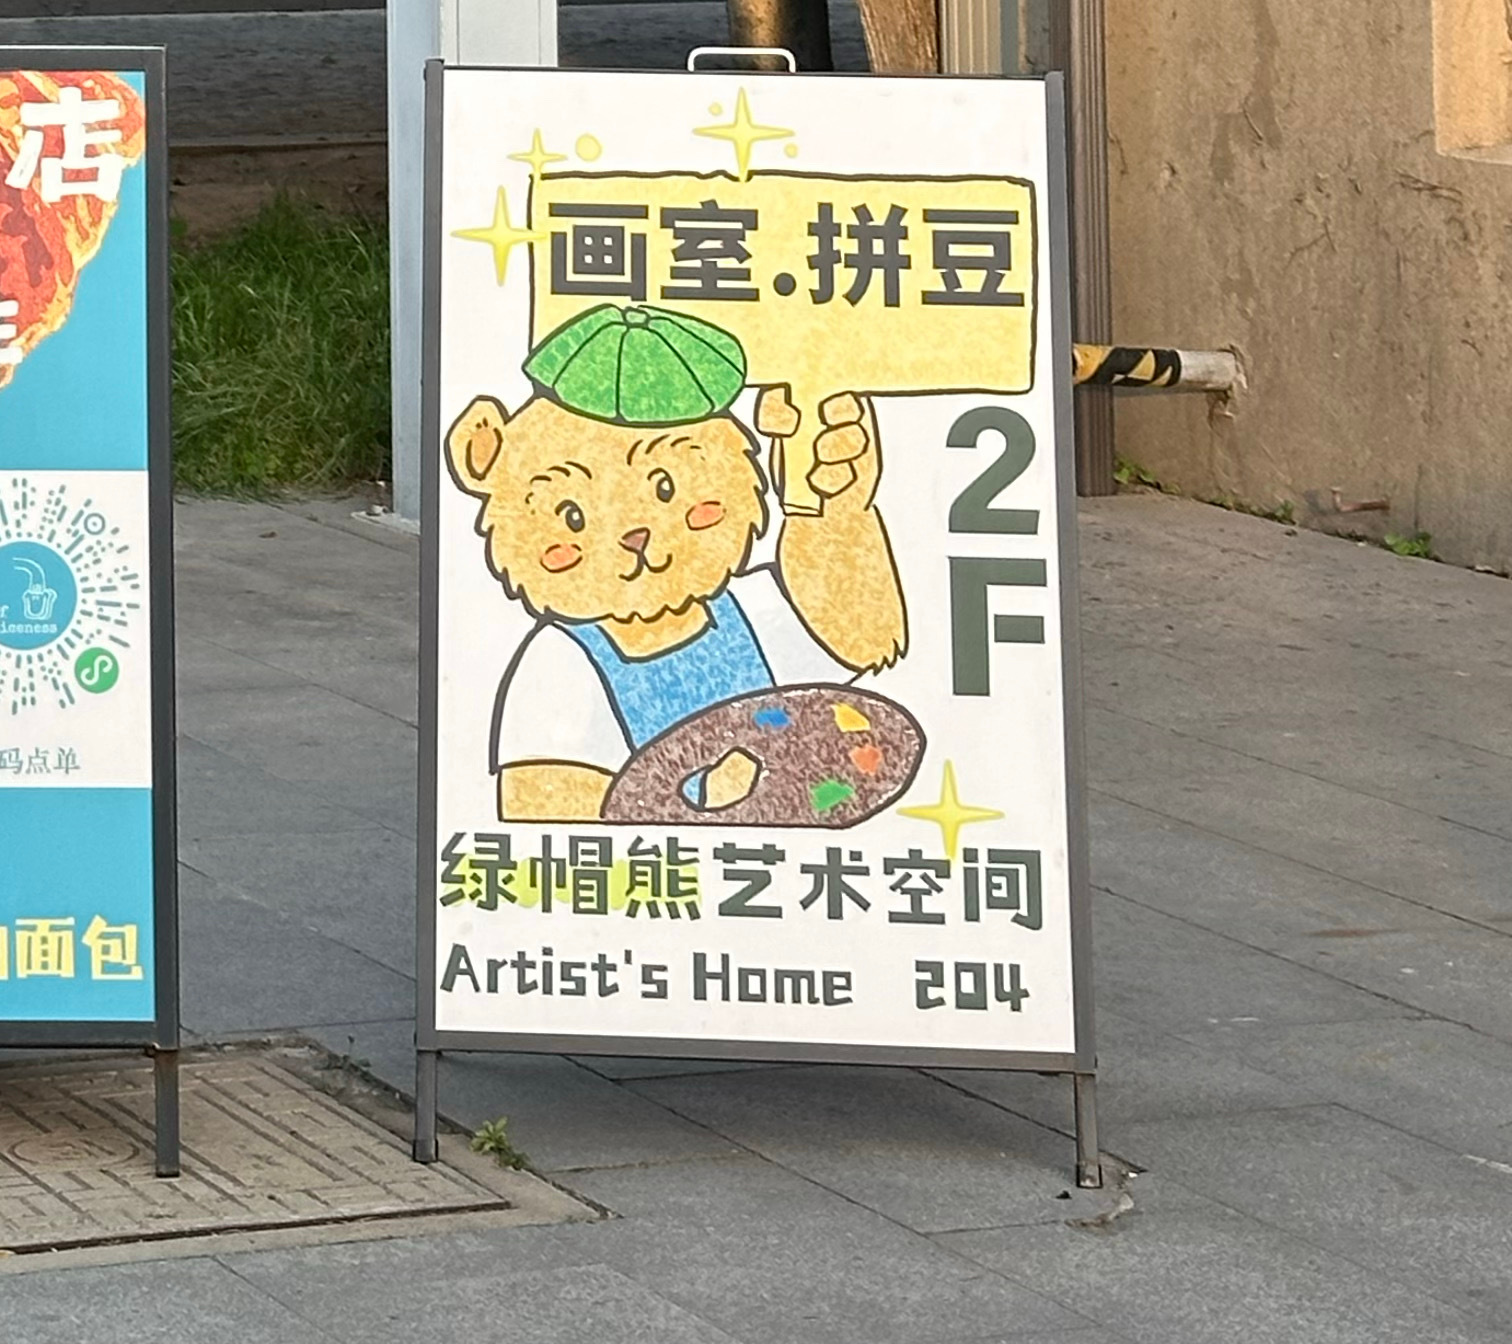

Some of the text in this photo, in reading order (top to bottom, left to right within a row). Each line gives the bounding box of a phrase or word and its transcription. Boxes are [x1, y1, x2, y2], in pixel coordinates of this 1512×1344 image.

[946, 405, 1048, 697] 2F
[439, 831, 1044, 931] 绿帽熊艺术空间
[439, 943, 1031, 1012] Artist's Home 204
